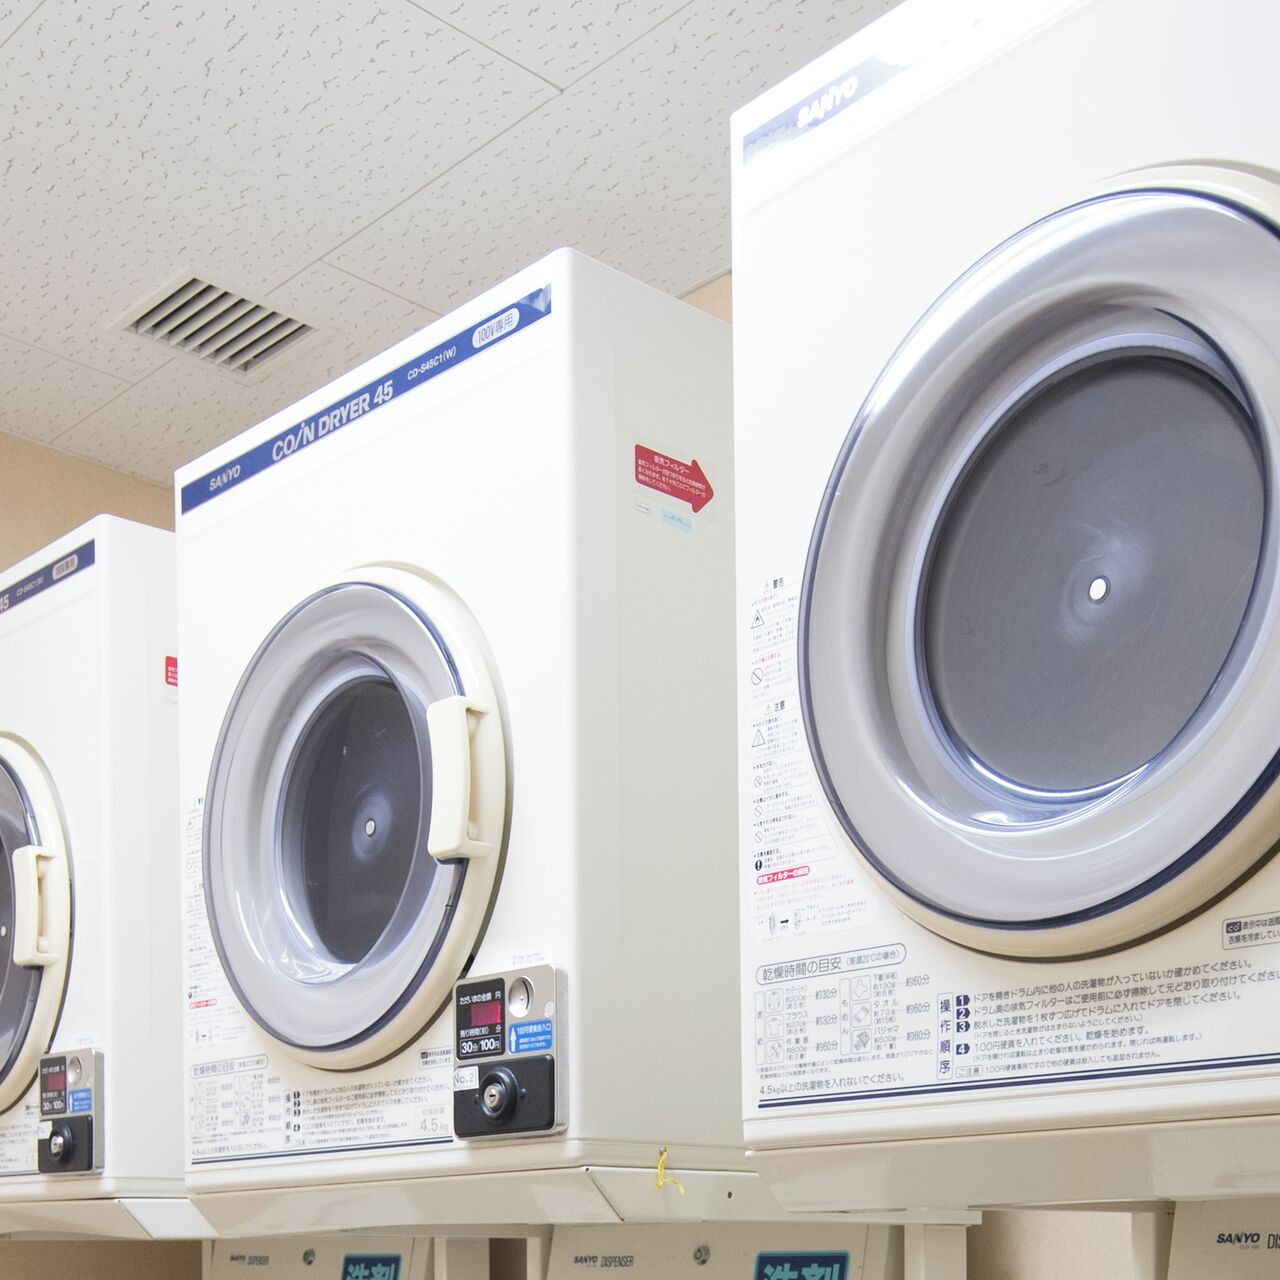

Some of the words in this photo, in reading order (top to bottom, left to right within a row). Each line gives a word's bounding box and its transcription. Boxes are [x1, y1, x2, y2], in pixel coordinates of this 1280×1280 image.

[208, 465, 241, 491] SANYO
[317, 393, 370, 438] DRYER
[374, 379, 394, 405] 45
[762, 959, 842, 982] 乾燥時間の目安
[1216, 1231, 1261, 1246] SANYO
